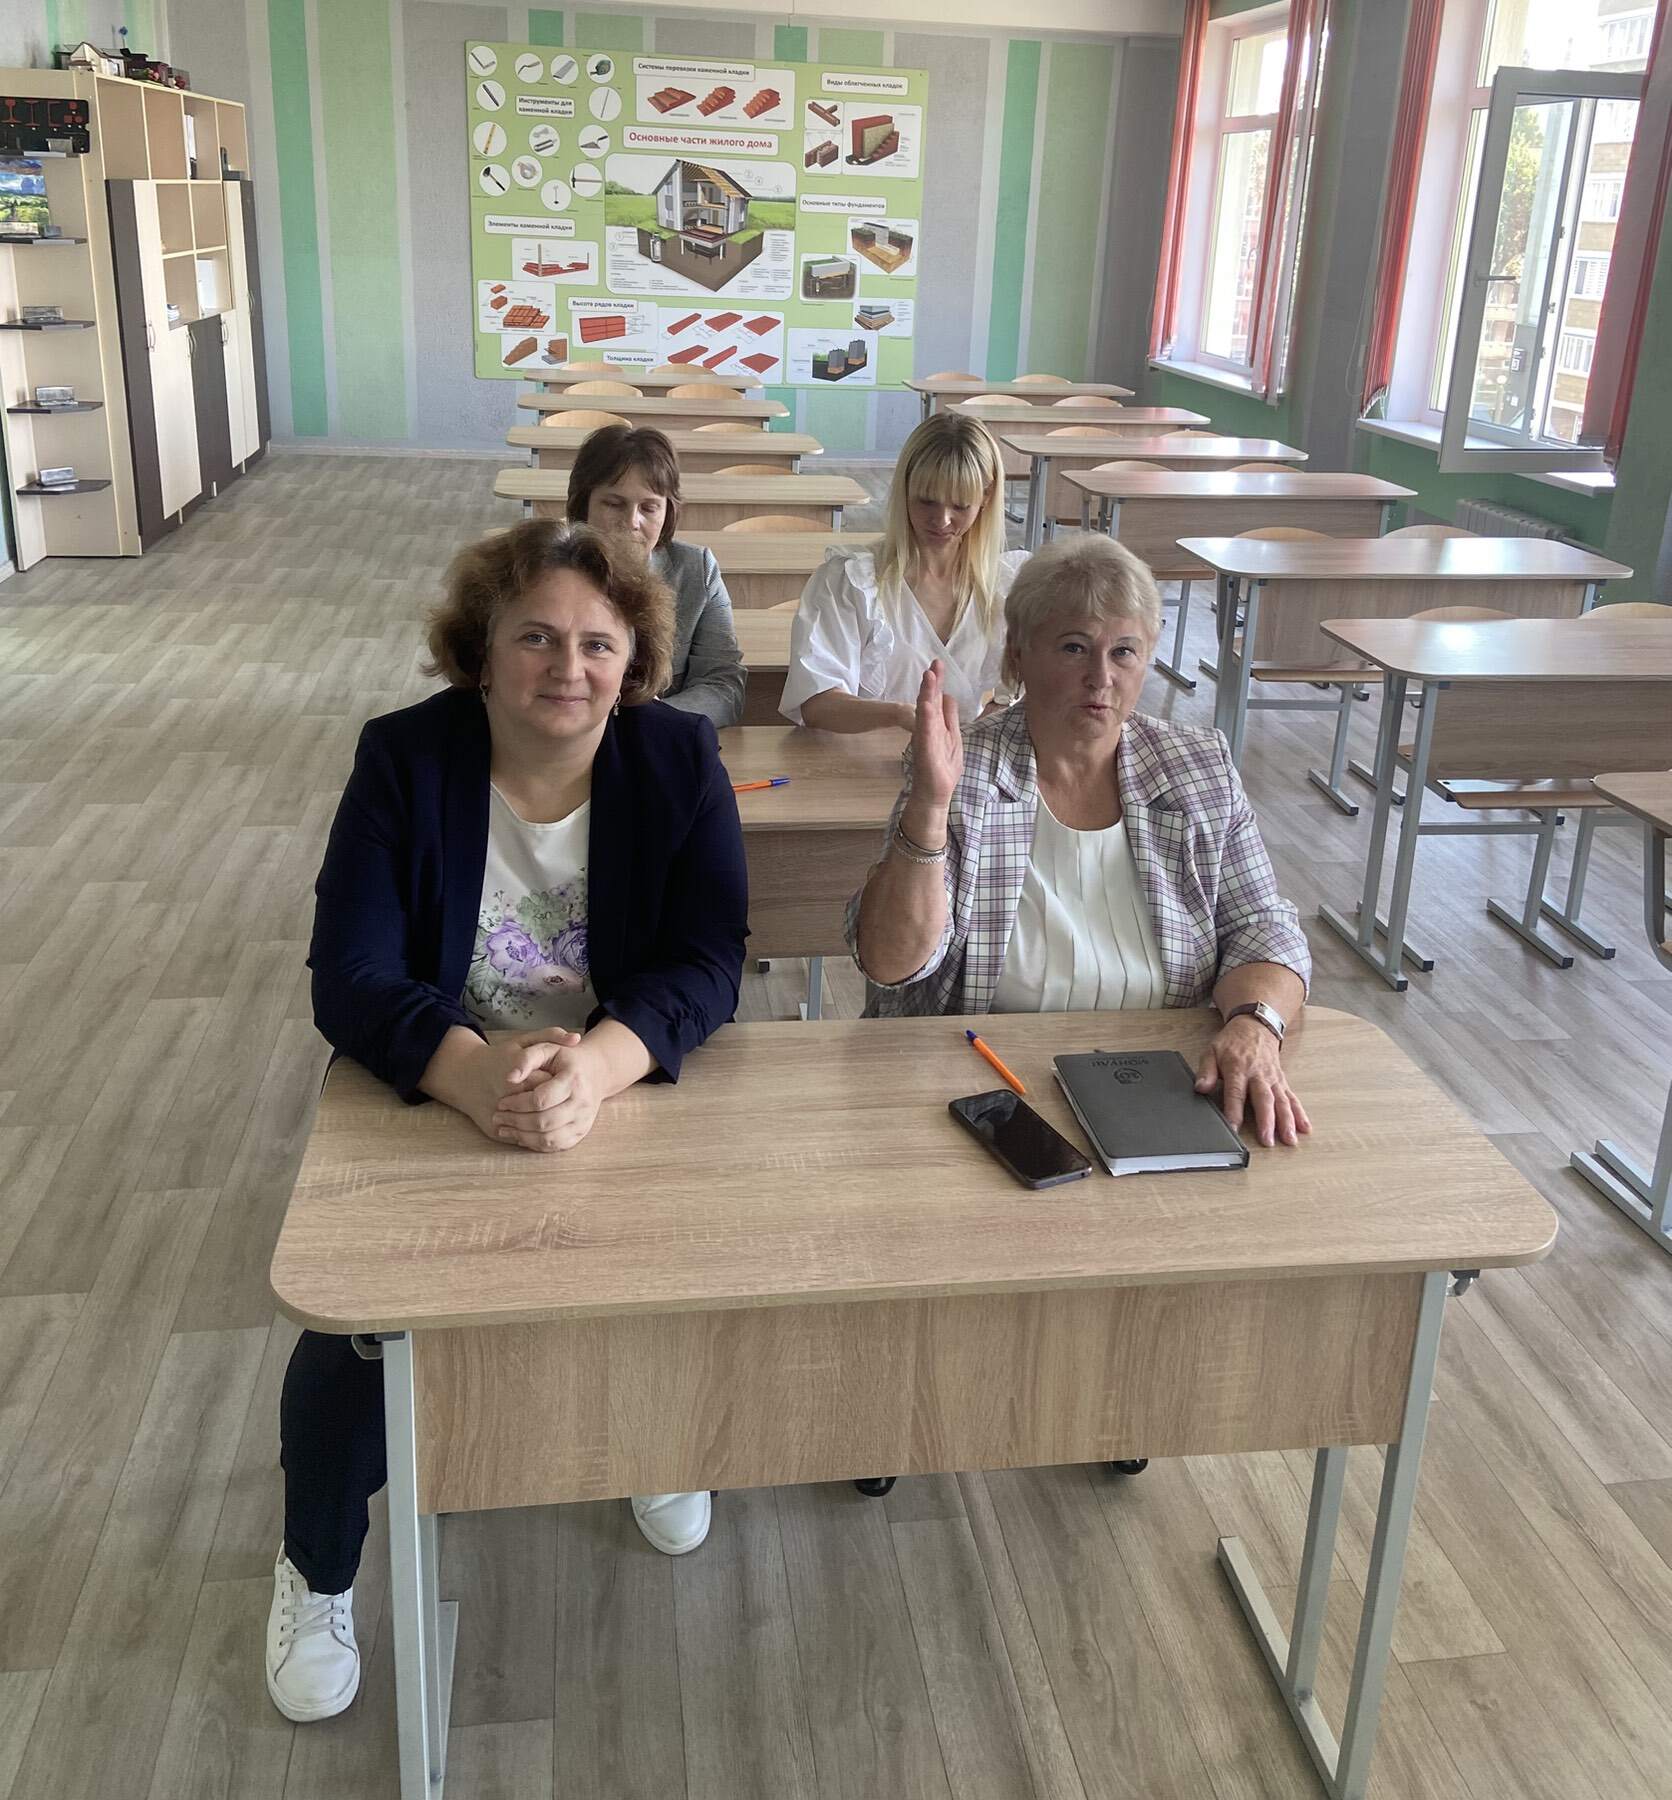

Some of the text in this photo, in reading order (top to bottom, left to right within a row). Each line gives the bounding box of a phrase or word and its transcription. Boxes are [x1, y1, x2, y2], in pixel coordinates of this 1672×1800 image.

[629, 132, 773, 149] Основные части жилого дома
[488, 220, 518, 228] Элементы
